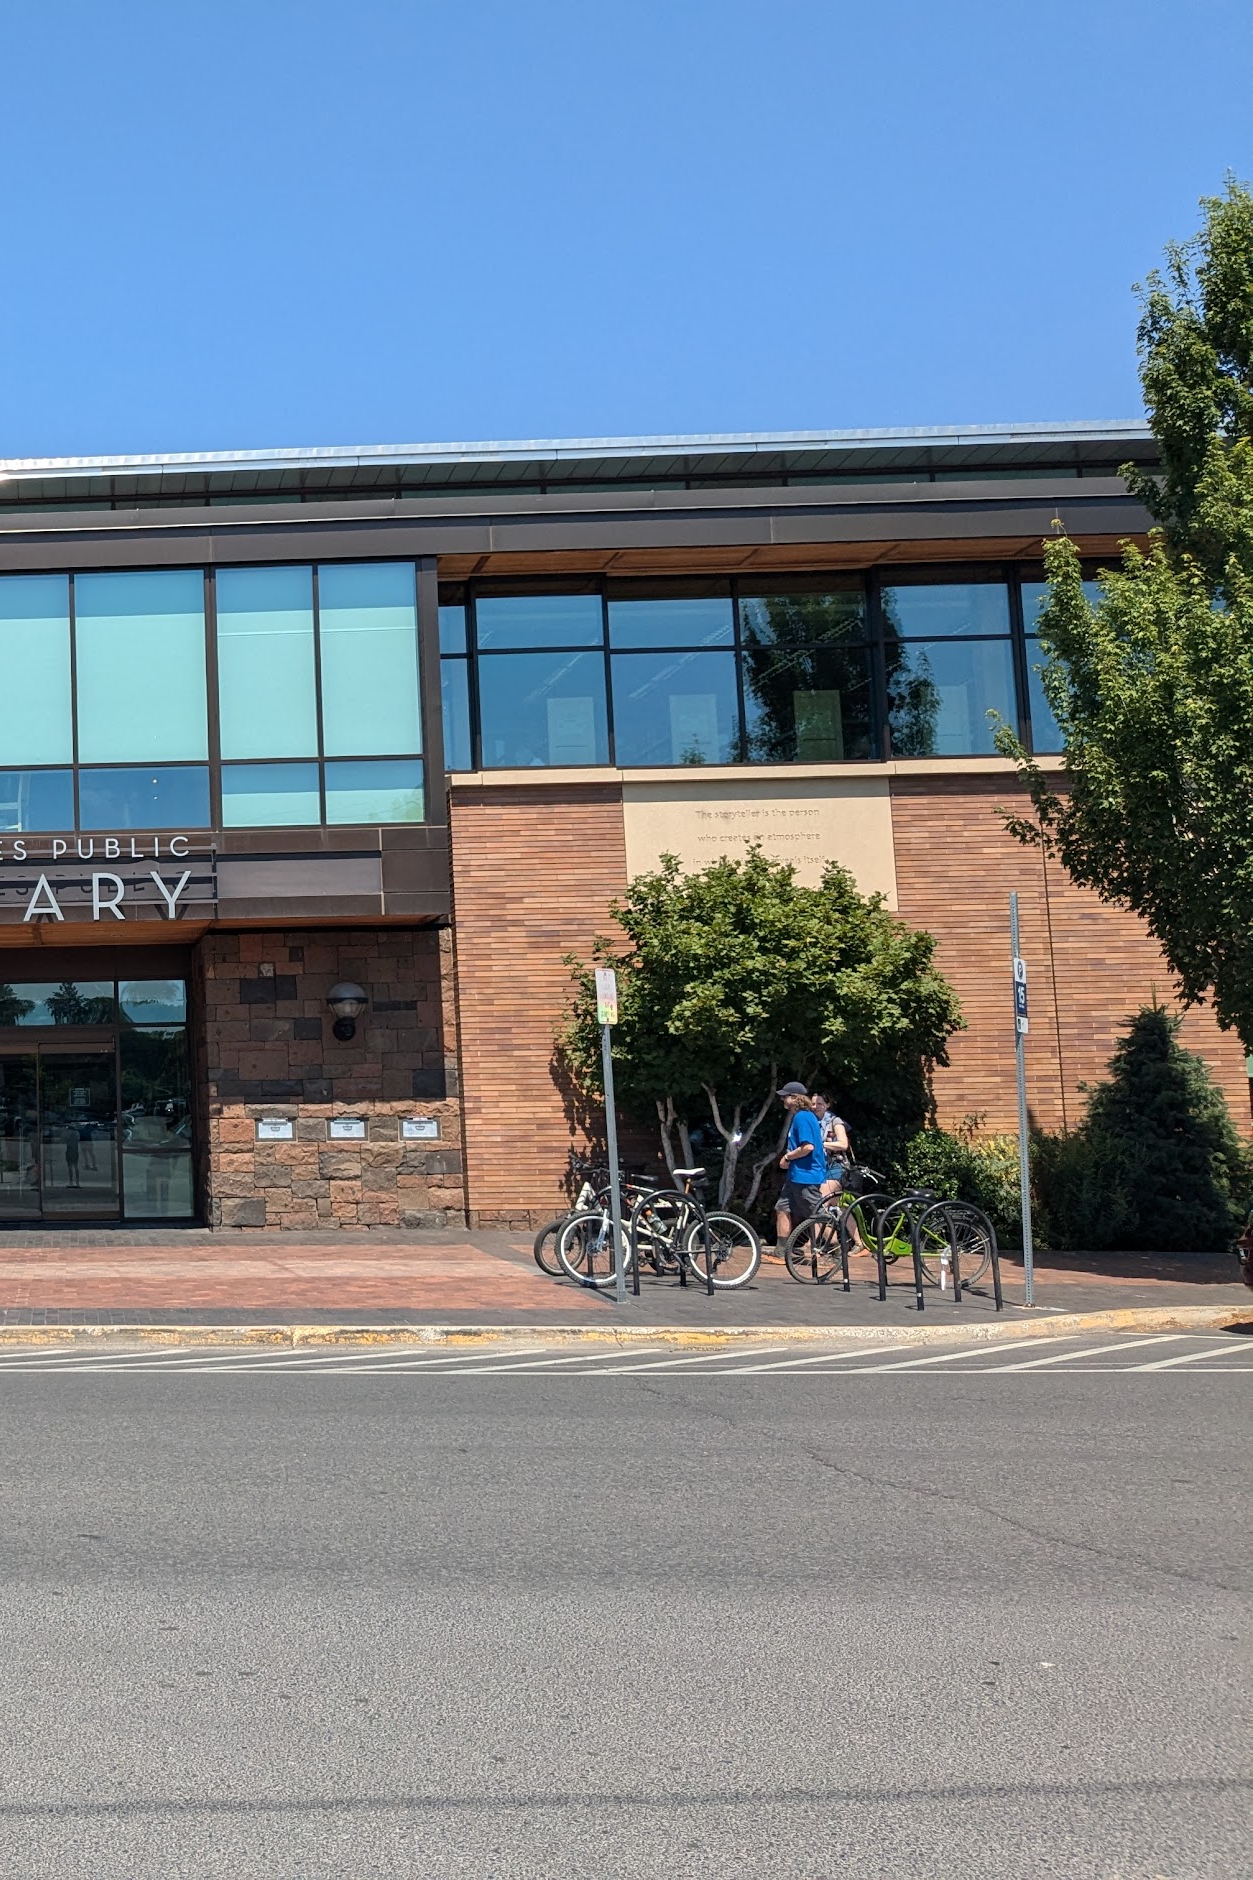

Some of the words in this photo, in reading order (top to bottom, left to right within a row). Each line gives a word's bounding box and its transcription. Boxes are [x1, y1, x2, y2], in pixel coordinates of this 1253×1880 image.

[695, 809, 712, 819] The
[714, 808, 760, 820] storyteller
[762, 808, 770, 817] is
[771, 808, 787, 817] the
[788, 808, 820, 818] person
[697, 833, 717, 842] who
[719, 833, 751, 842] creates
[767, 831, 821, 842] atmosphere
[52, 836, 190, 860] PUBLIC
[1017, 985, 1025, 1004] 15
